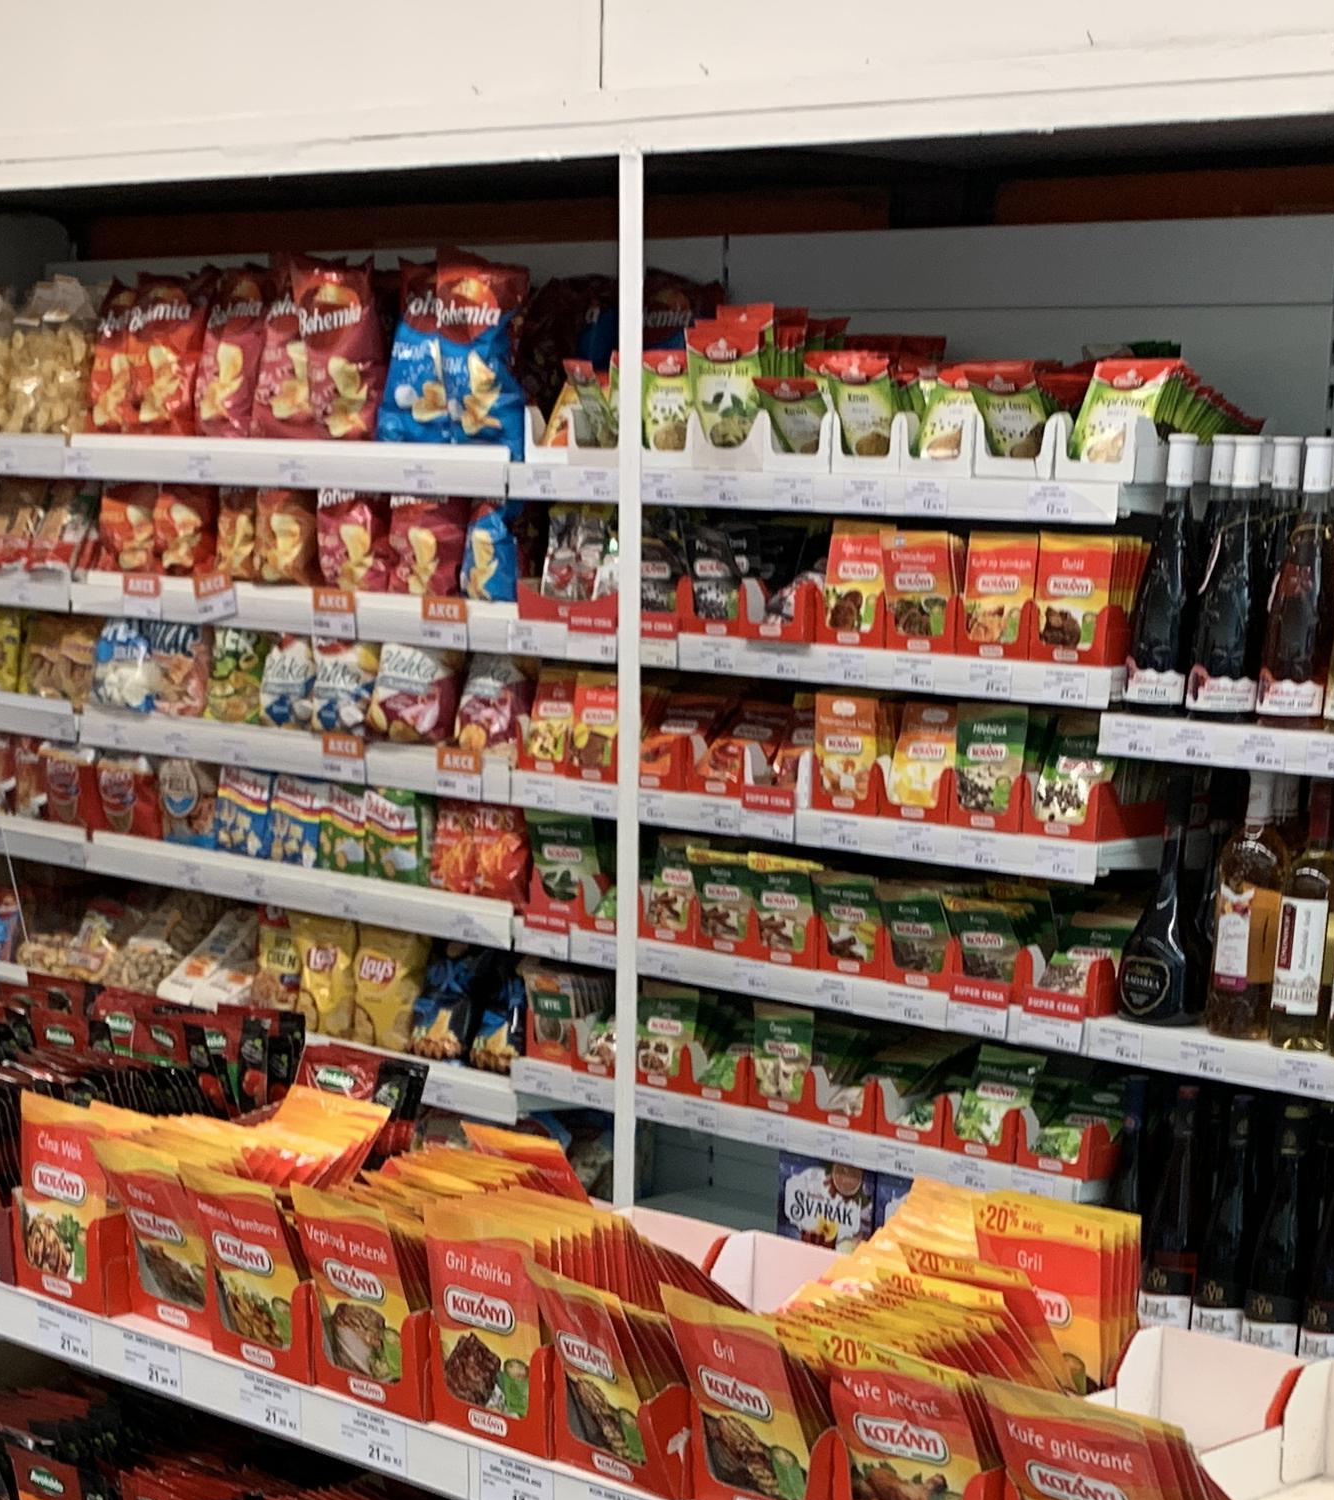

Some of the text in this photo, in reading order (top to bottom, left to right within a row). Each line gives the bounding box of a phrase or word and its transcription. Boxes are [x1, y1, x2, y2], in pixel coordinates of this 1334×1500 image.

[127, 578, 156, 594] AKCE
[198, 576, 228, 594] AKCE
[318, 592, 350, 609] AKCE
[427, 602, 460, 620] AKCE
[326, 737, 359, 755] AKCE
[443, 752, 475, 770] AKCE
[359, 956, 396, 985] Lay's
[953, 984, 1005, 1004] SUPER CENA
[1028, 996, 1081, 1016] SUPER CENA
[218, 1237, 268, 1271] KOTÁNYI
[445, 1250, 468, 1274] Gril
[1017, 1250, 1044, 1272] Gril
[451, 1291, 508, 1327] KOTÁNYI
[712, 1339, 736, 1365] Gril
[705, 1375, 767, 1415] KOTÁNYI
[862, 1418, 942, 1458] KOTÁNYI
[1006, 1420, 1134, 1475] Kuře grilované
